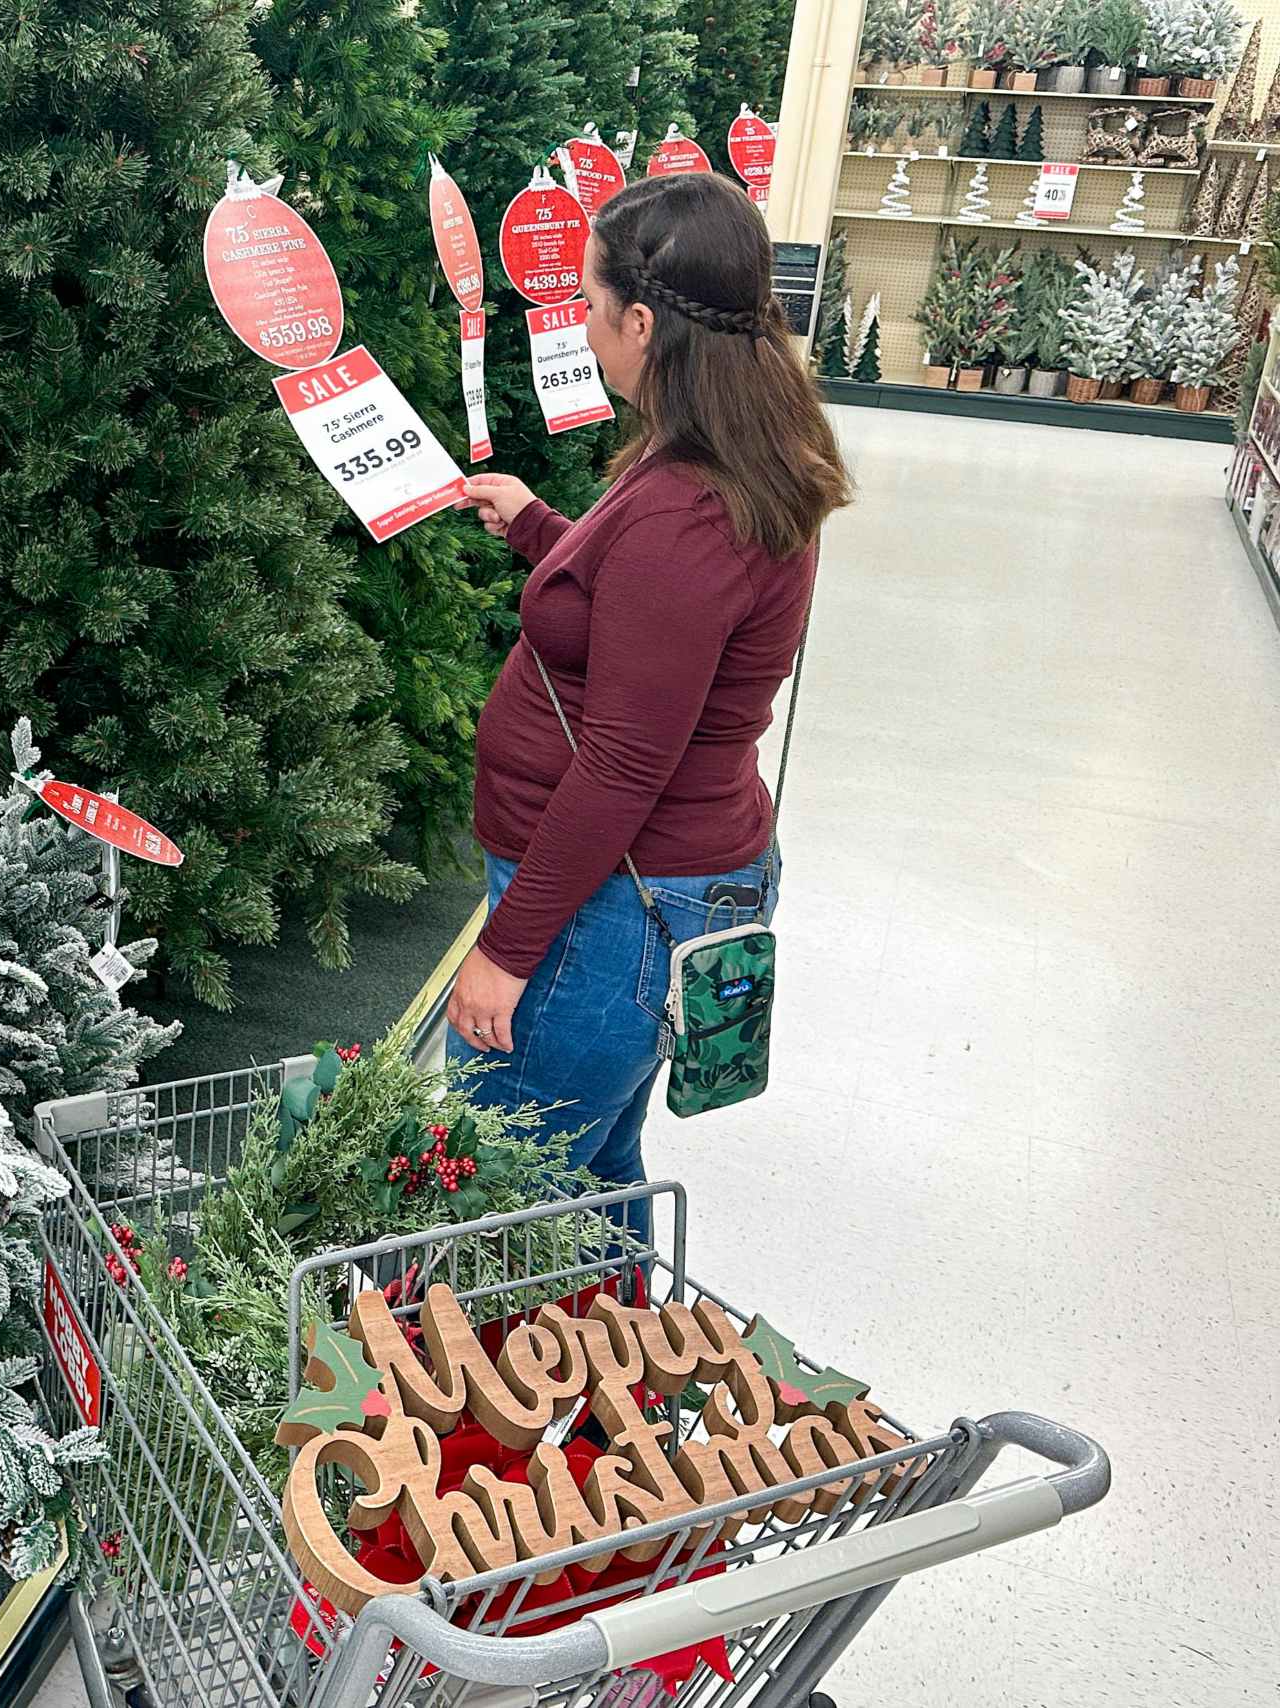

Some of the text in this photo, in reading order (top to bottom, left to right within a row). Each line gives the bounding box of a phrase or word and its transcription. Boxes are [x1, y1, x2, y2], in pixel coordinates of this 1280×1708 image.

[755, 188, 769, 200] SAL
[252, 225, 291, 240] SIERRA
[222, 243, 282, 263] CASHMERE
[282, 238, 307, 250] PINE
[524, 272, 579, 290] $439.98
[259, 315, 333, 347] $559.98
[466, 317, 481, 337] SALE
[542, 308, 577, 330] SALE
[298, 365, 358, 405] SALE
[540, 366, 592, 390] 263.99
[343, 402, 377, 424] Sierra
[330, 412, 385, 444] Cashmere
[333, 429, 421, 482] 335.99
[49, 1275, 90, 1380] HOBBY
[350, 1283, 776, 1440] Merry
[283, 1400, 927, 1610] Christmas
